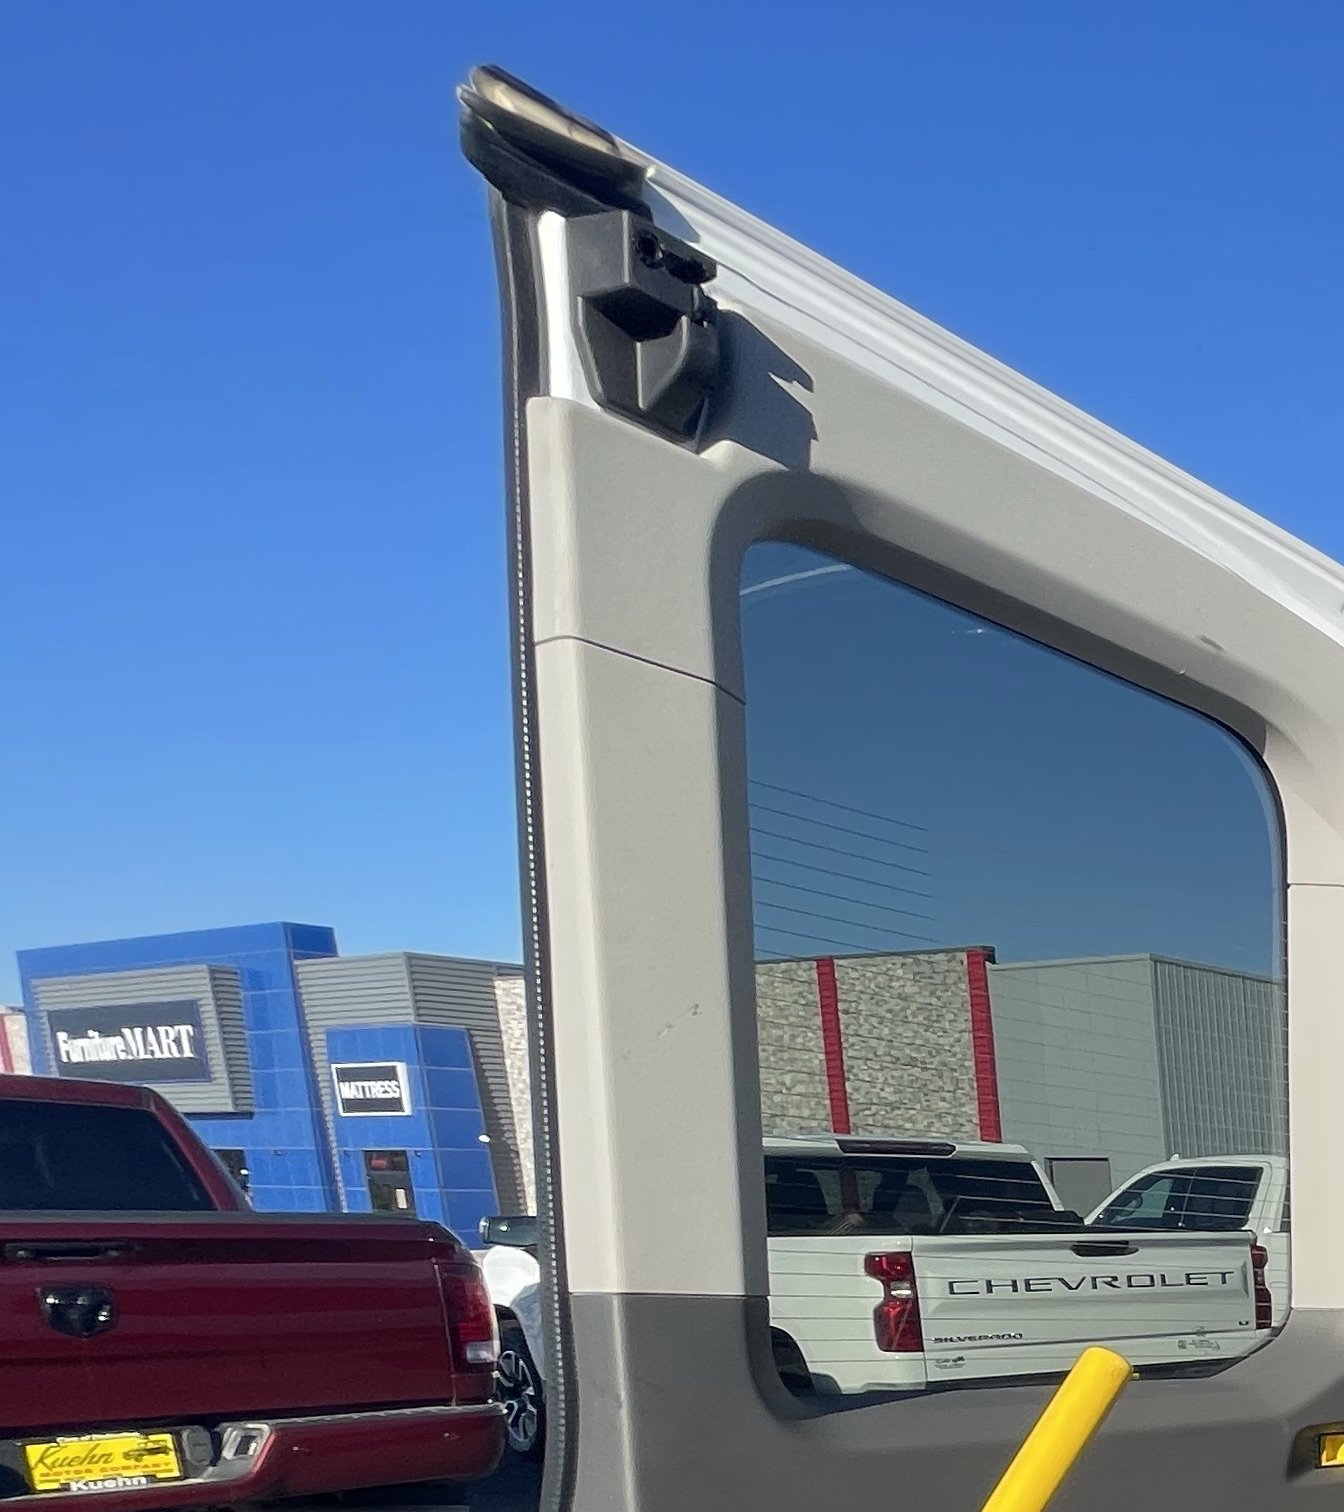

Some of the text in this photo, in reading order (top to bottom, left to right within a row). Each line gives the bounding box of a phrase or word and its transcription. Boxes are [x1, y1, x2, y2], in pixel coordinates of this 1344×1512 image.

[56, 1024, 195, 1064] FurnitureMART
[338, 1079, 401, 1099] MATTRESS
[947, 1270, 1236, 1296] CHEVROLET
[933, 1332, 1023, 1344] SILVERADO
[32, 1443, 114, 1472] Kuehn
[69, 1476, 148, 1492] Kuehn
